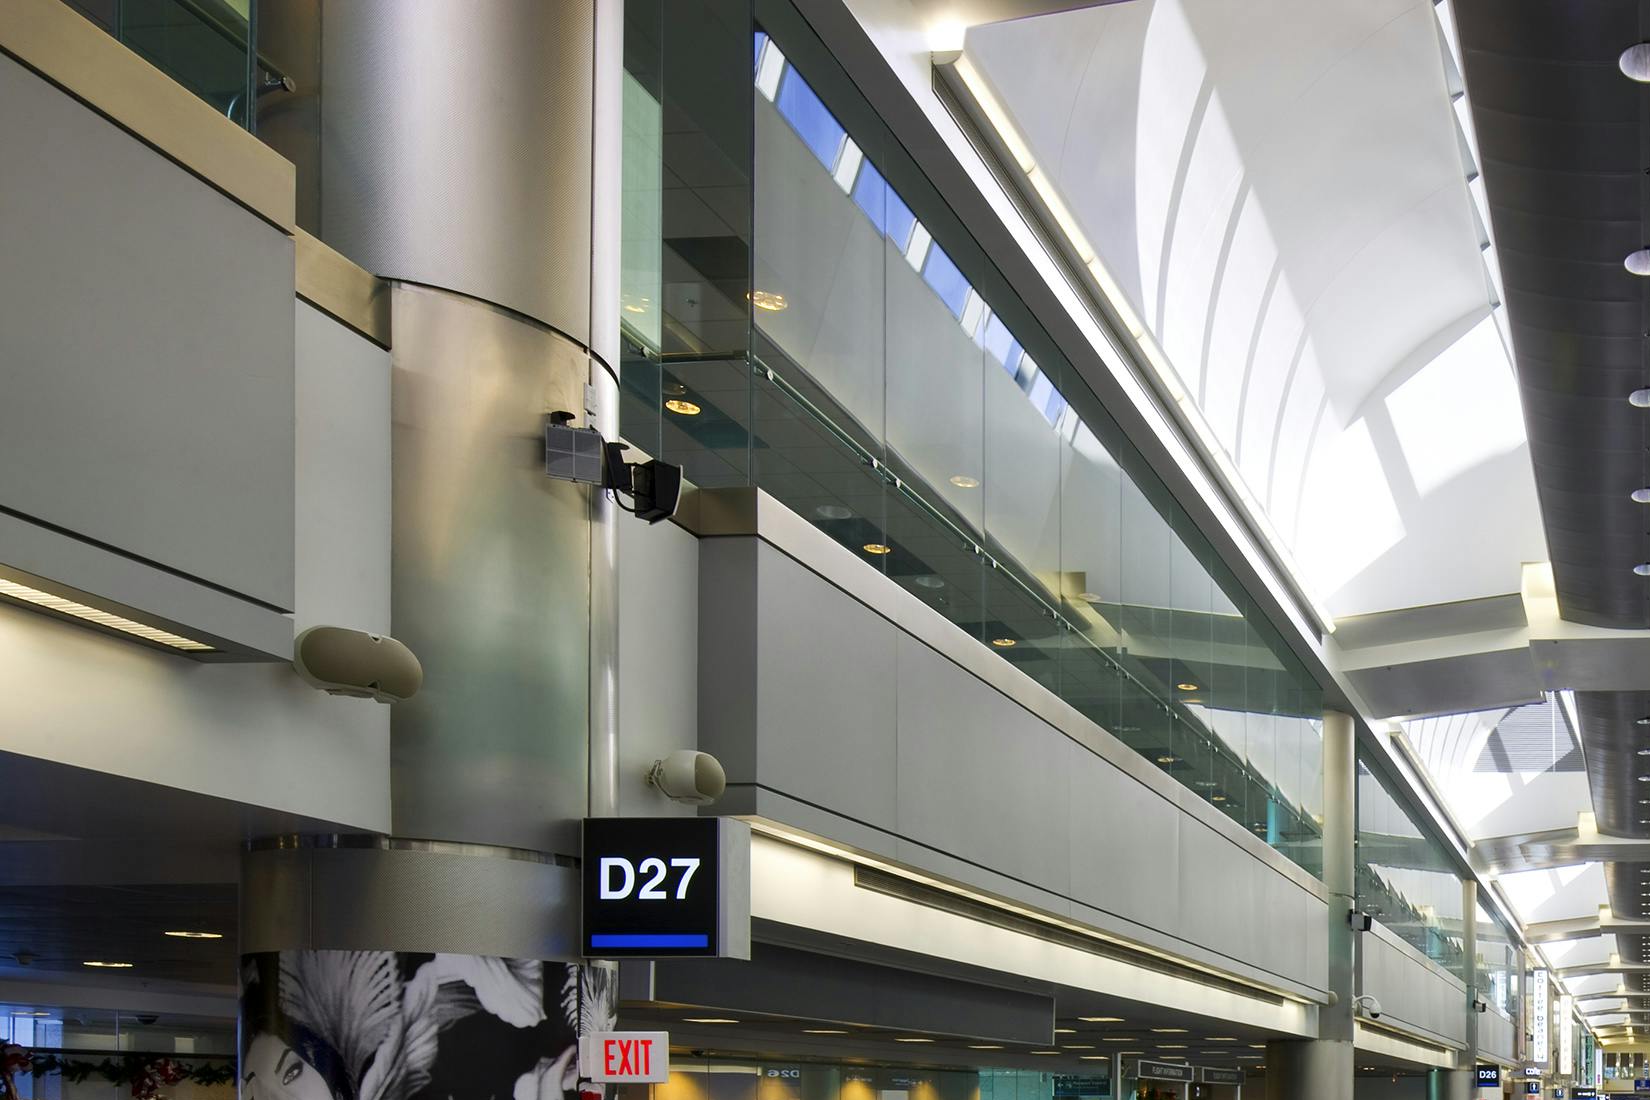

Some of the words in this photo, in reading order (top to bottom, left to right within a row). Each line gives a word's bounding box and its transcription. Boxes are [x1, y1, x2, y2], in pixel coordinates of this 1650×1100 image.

[600, 857, 701, 900] D27
[604, 1040, 652, 1076] EXIT
[1479, 1070, 1497, 1079] D26
